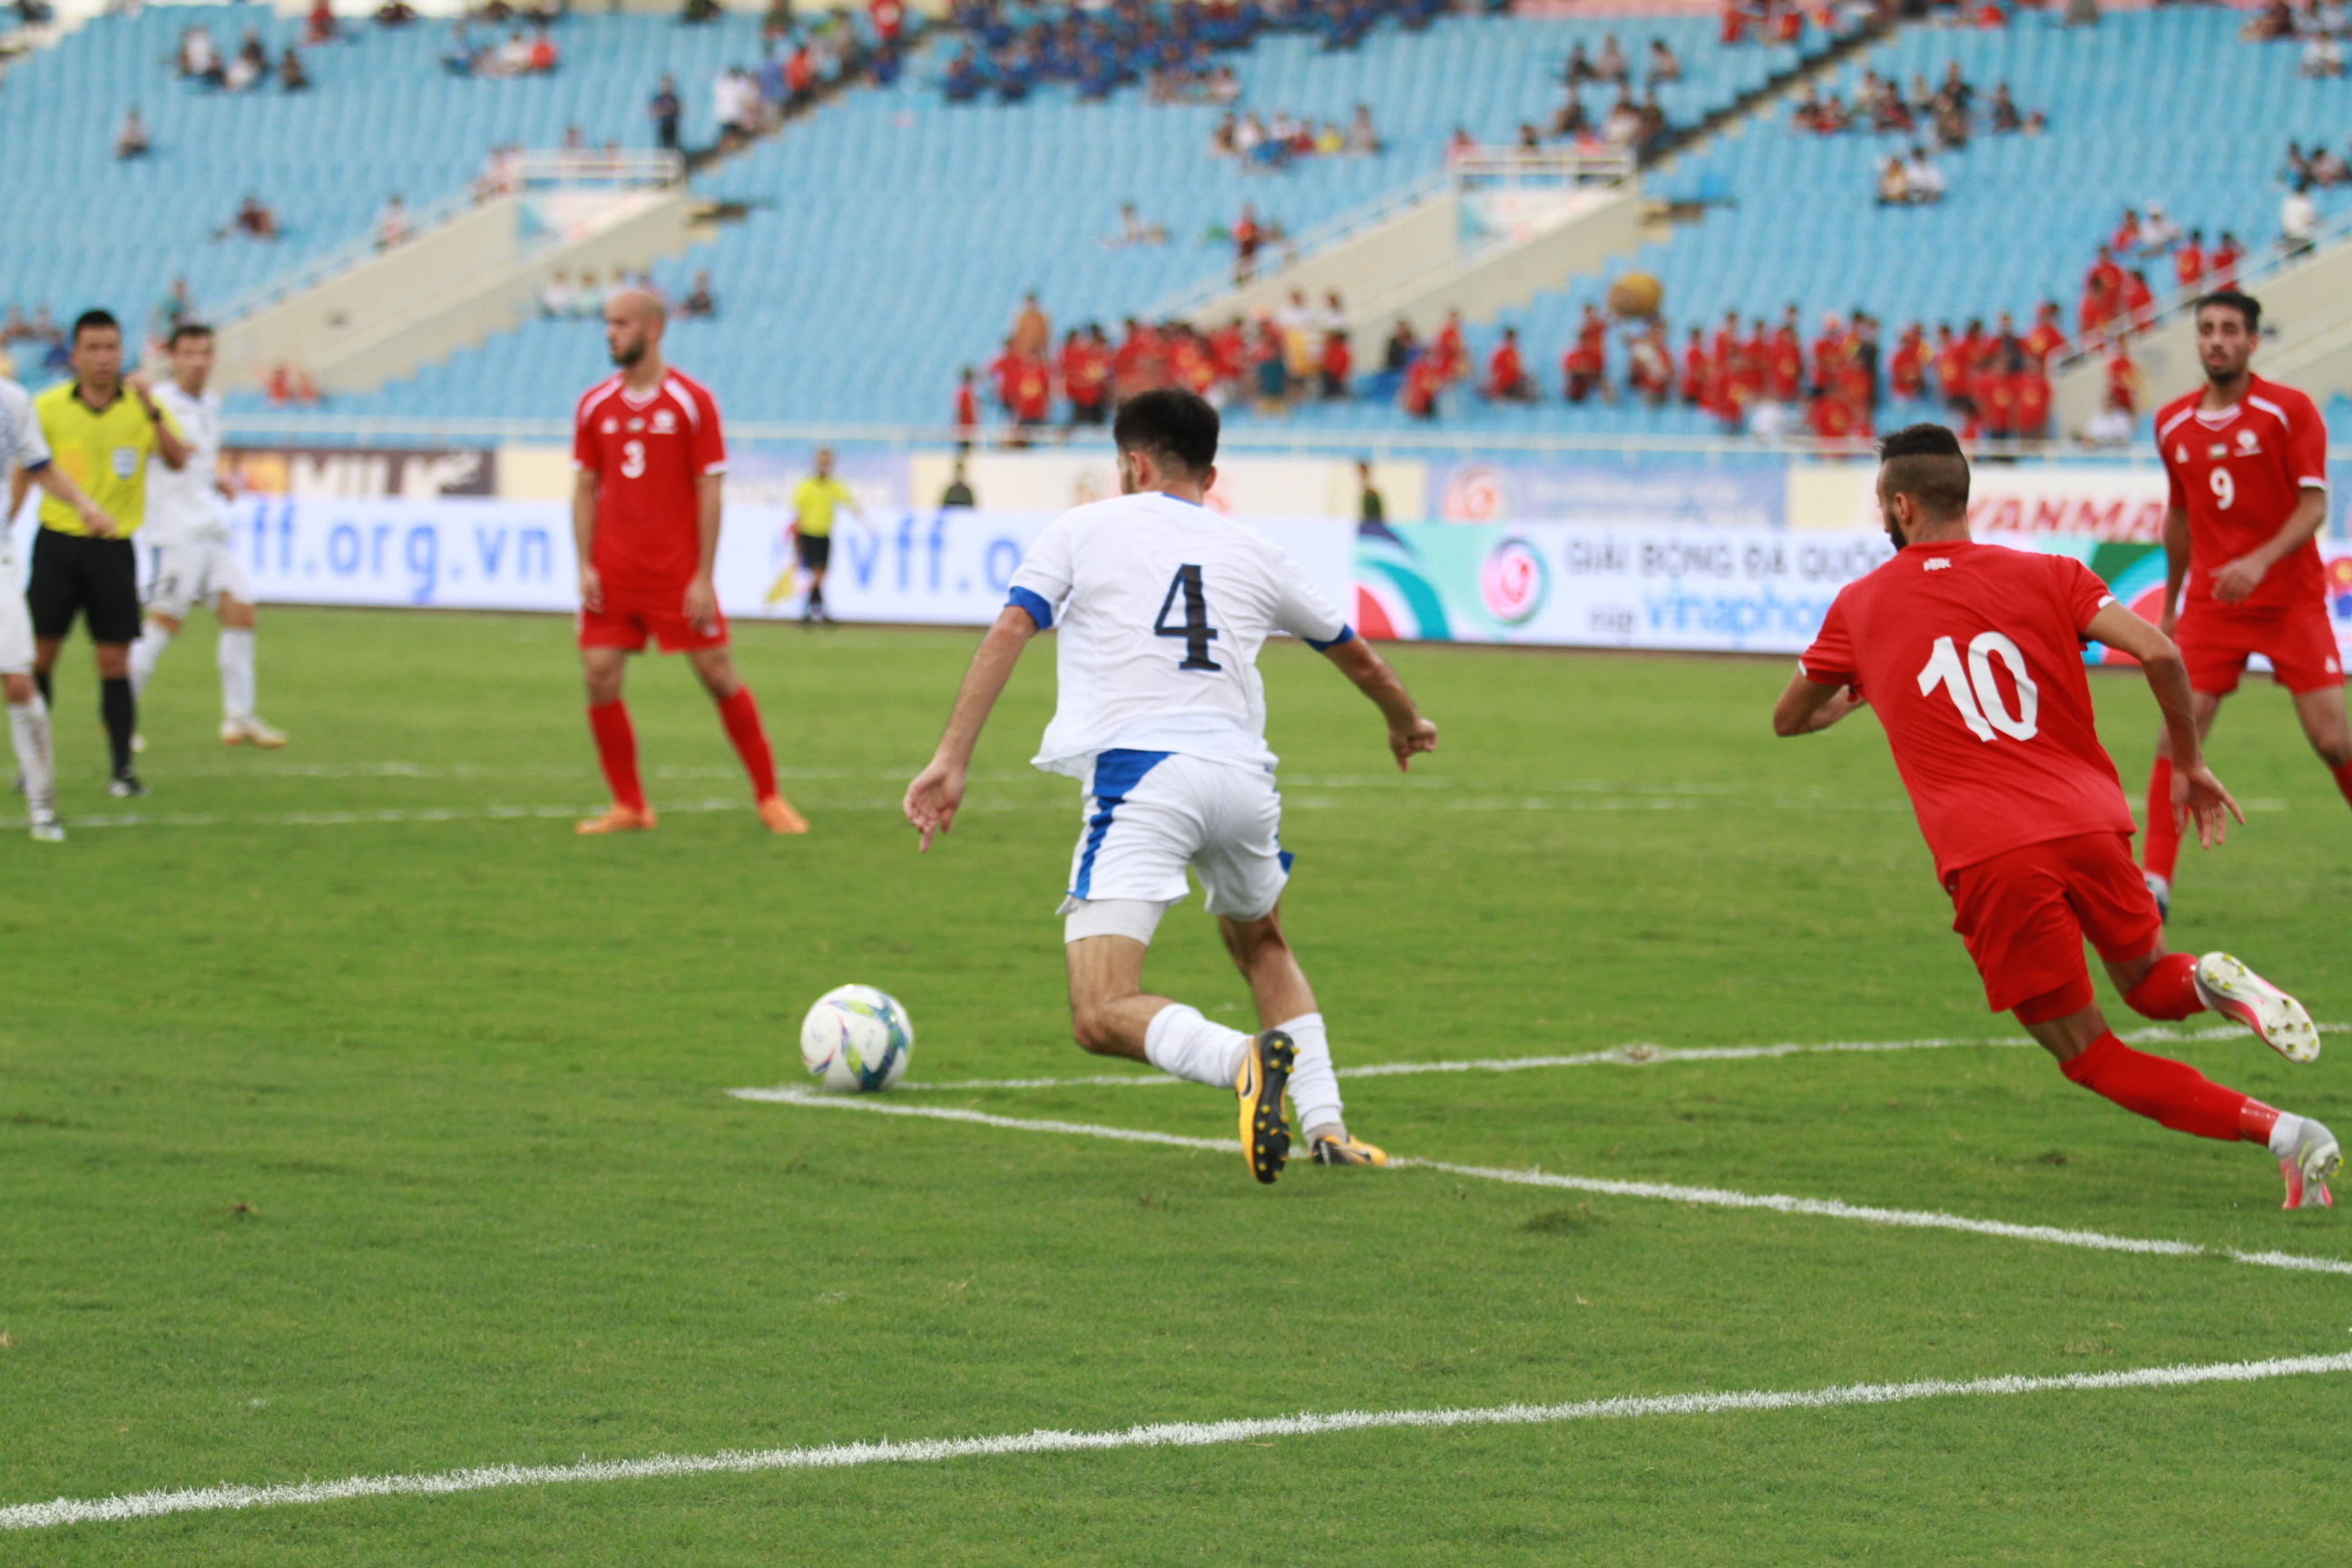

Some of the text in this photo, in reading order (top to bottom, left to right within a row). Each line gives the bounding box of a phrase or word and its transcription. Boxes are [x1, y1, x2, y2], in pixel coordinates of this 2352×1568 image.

[620, 439, 646, 479] 3
[2209, 466, 2235, 510] 9
[229, 502, 552, 604] ff.org.vn
[1153, 563, 1222, 671] 4
[1916, 631, 2039, 742] 10
